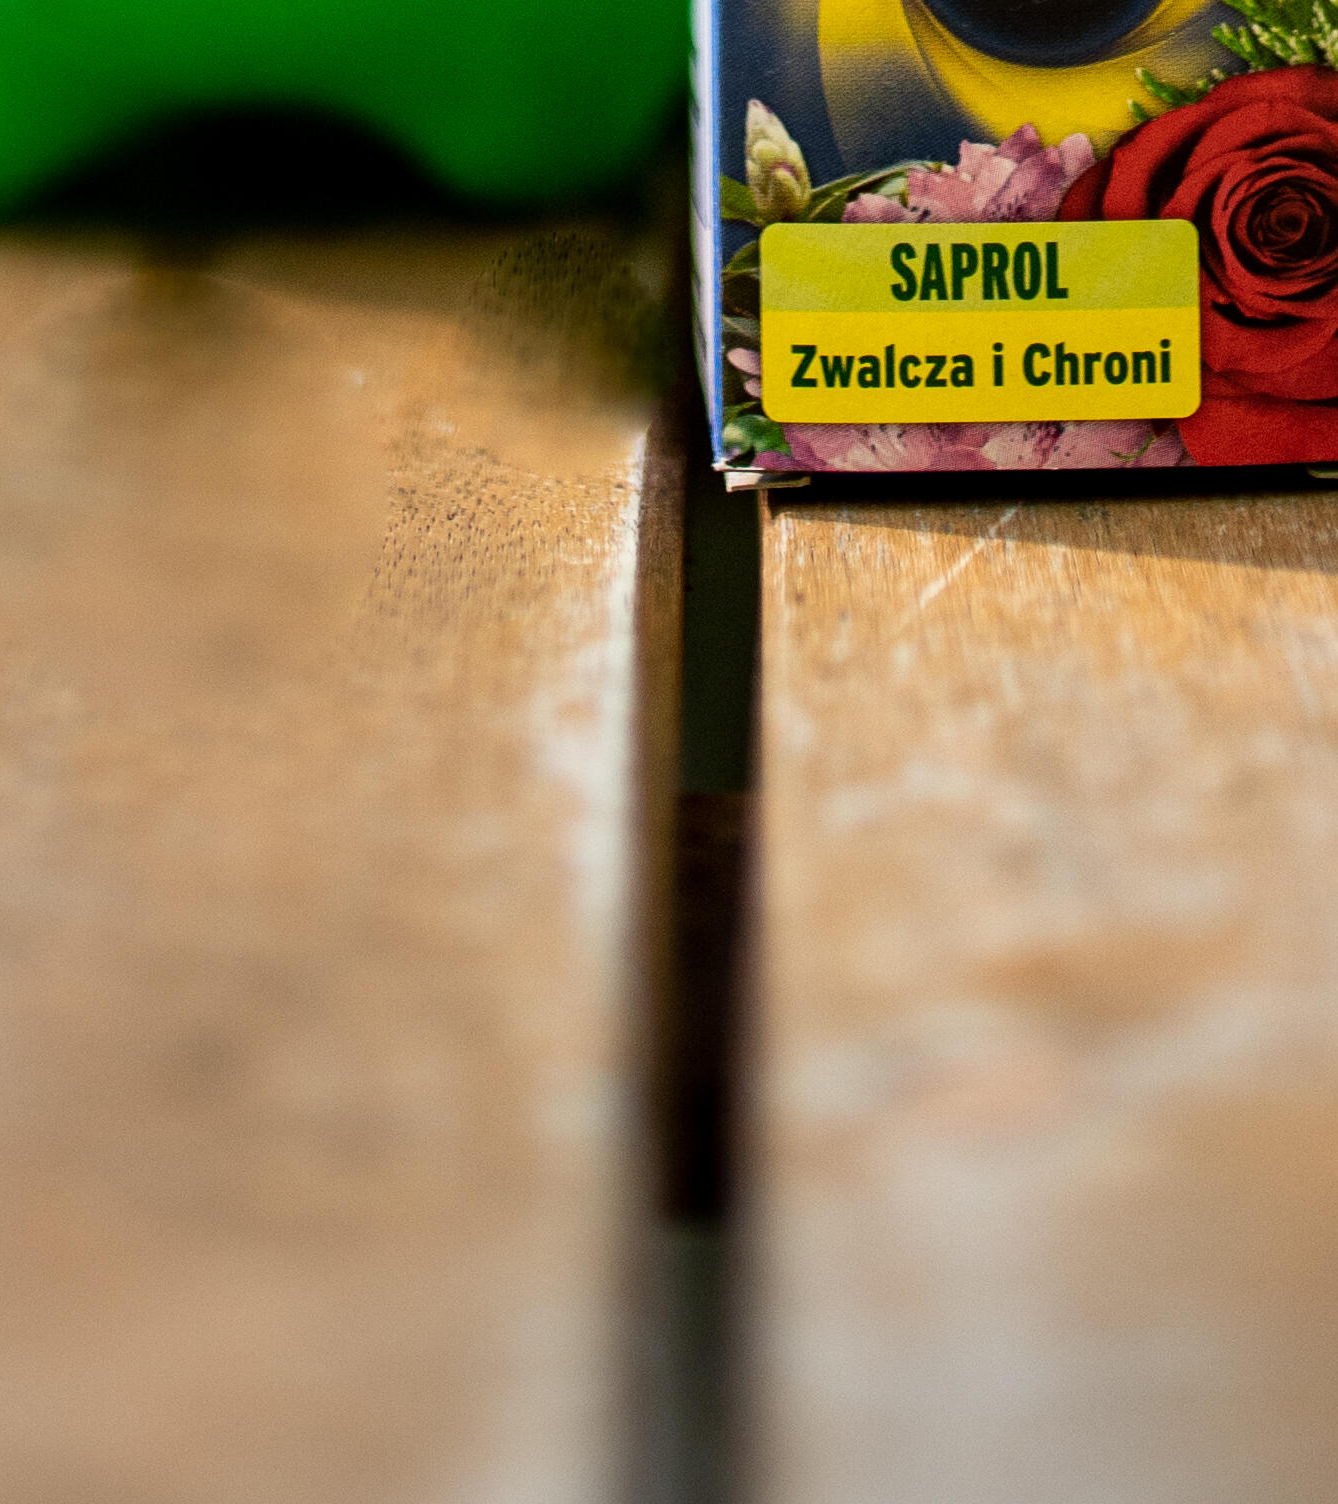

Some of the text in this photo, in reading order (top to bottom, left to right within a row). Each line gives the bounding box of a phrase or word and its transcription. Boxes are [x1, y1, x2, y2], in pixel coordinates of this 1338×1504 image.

[890, 241, 1069, 302] SAPROL
[791, 339, 1171, 389] Zwalcza i Chroni
